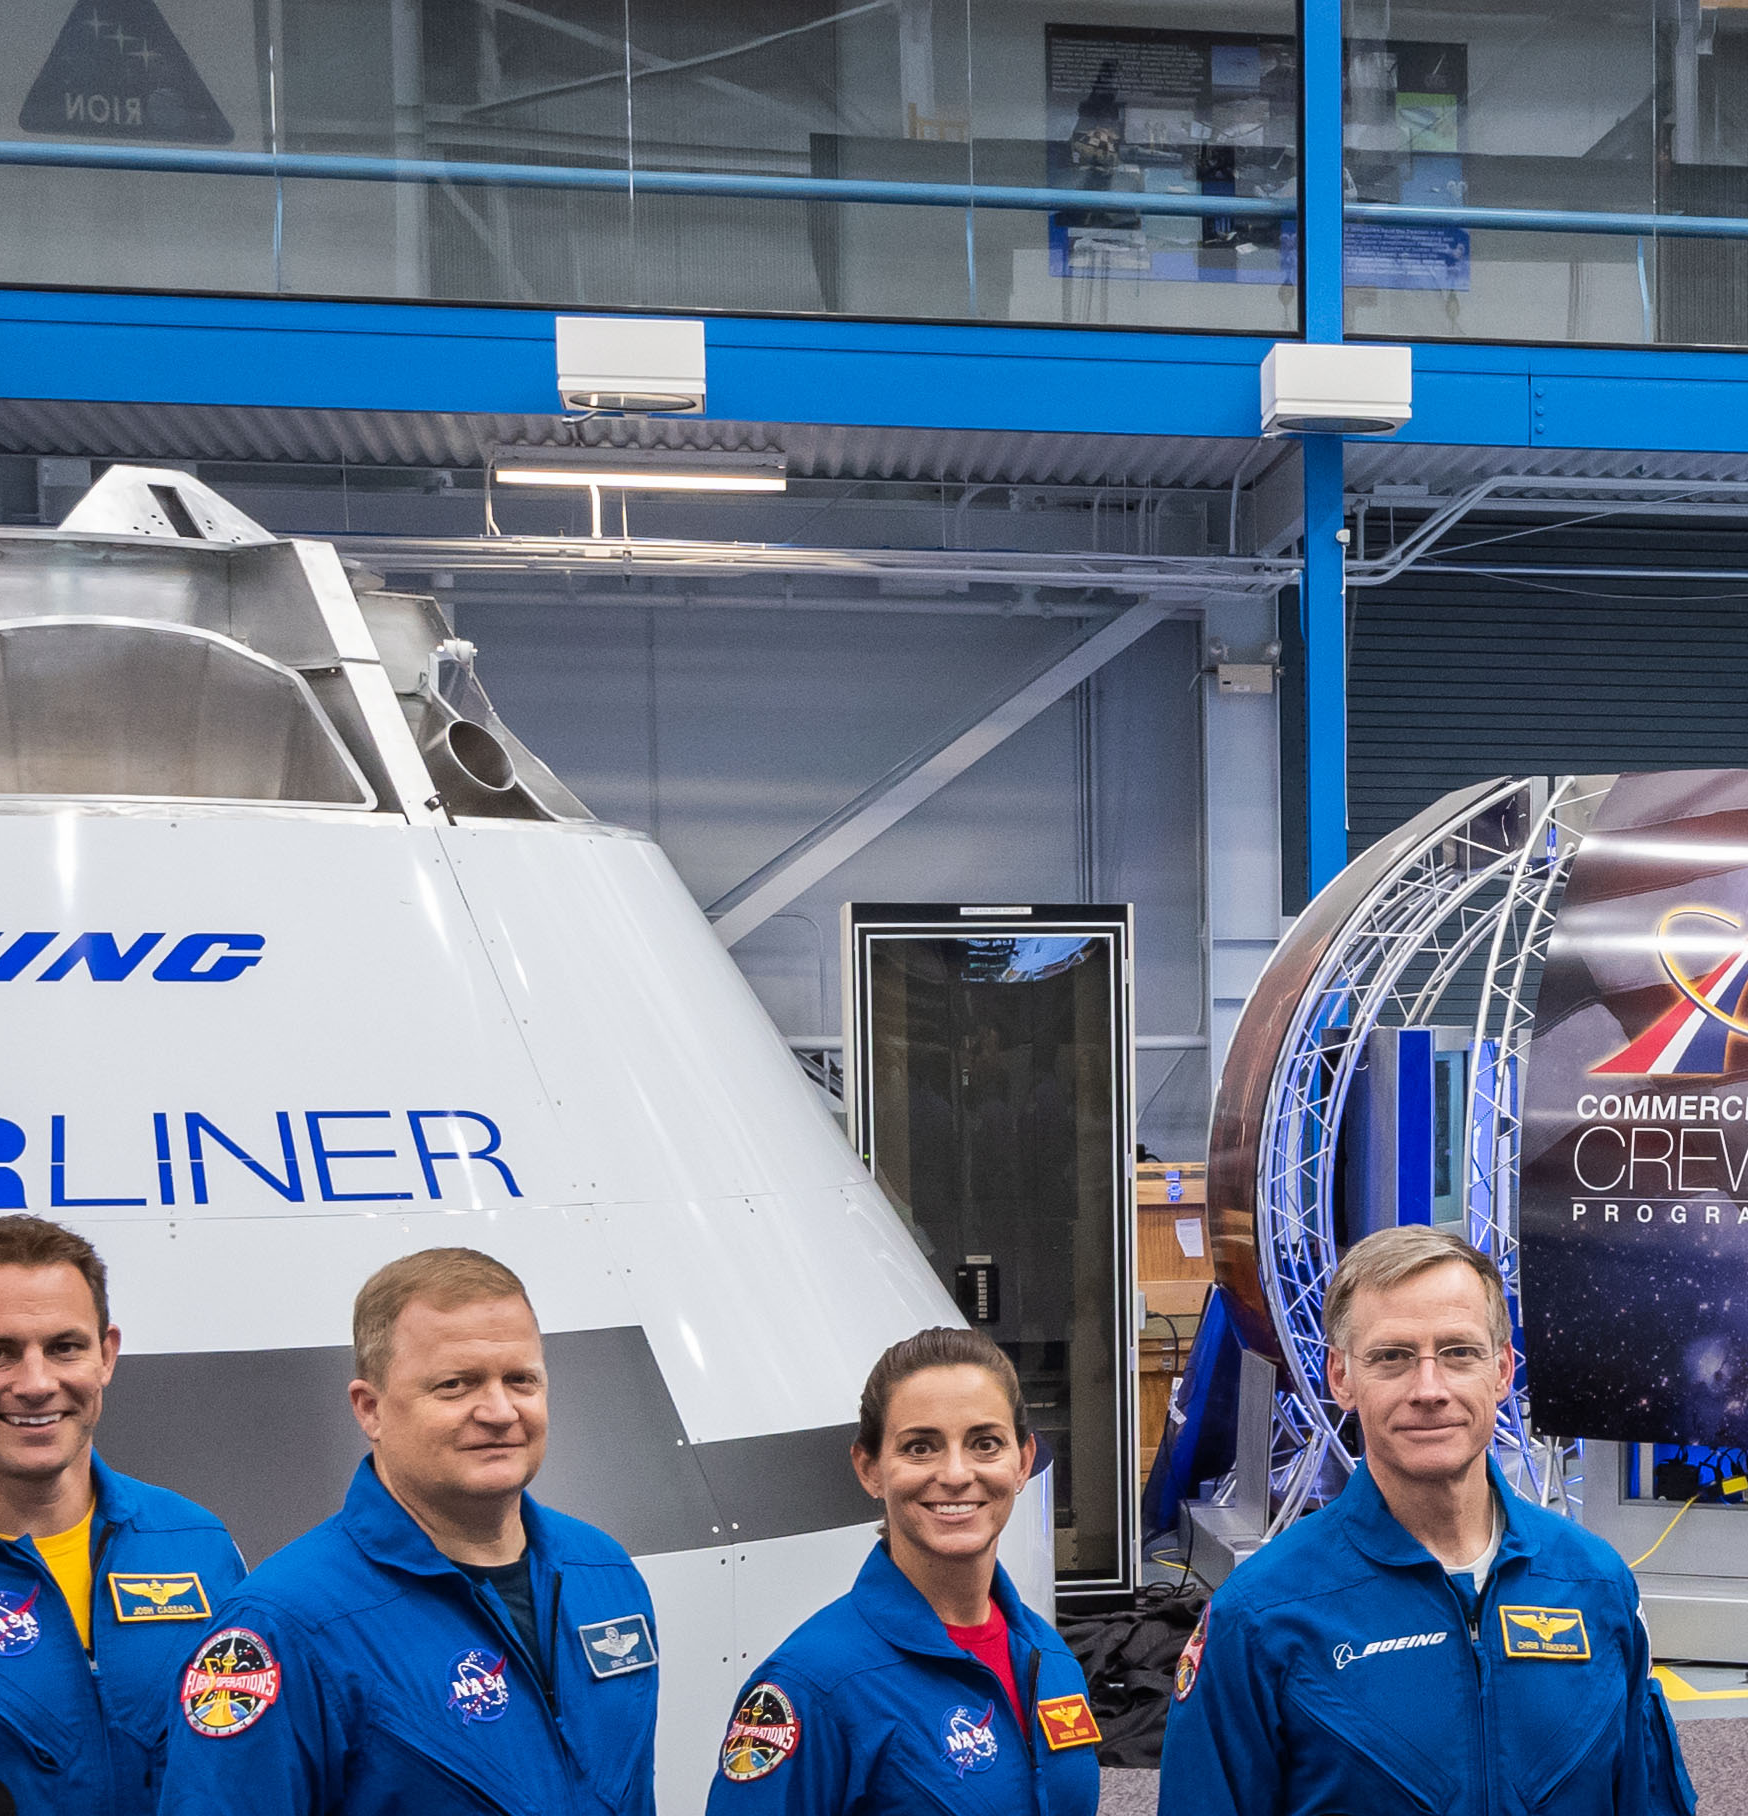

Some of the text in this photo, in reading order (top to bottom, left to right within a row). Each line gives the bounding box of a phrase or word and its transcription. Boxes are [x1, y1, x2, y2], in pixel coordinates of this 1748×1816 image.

[157, 1604, 197, 1614] CASSADA
[1362, 1632, 1448, 1656] BOEING
[1516, 1641, 1578, 1652] CHRIS FERGUSON
[215, 1670, 277, 1697] OPERATIONS
[451, 1673, 508, 1699] NASA
[945, 1726, 996, 1752] NASA
